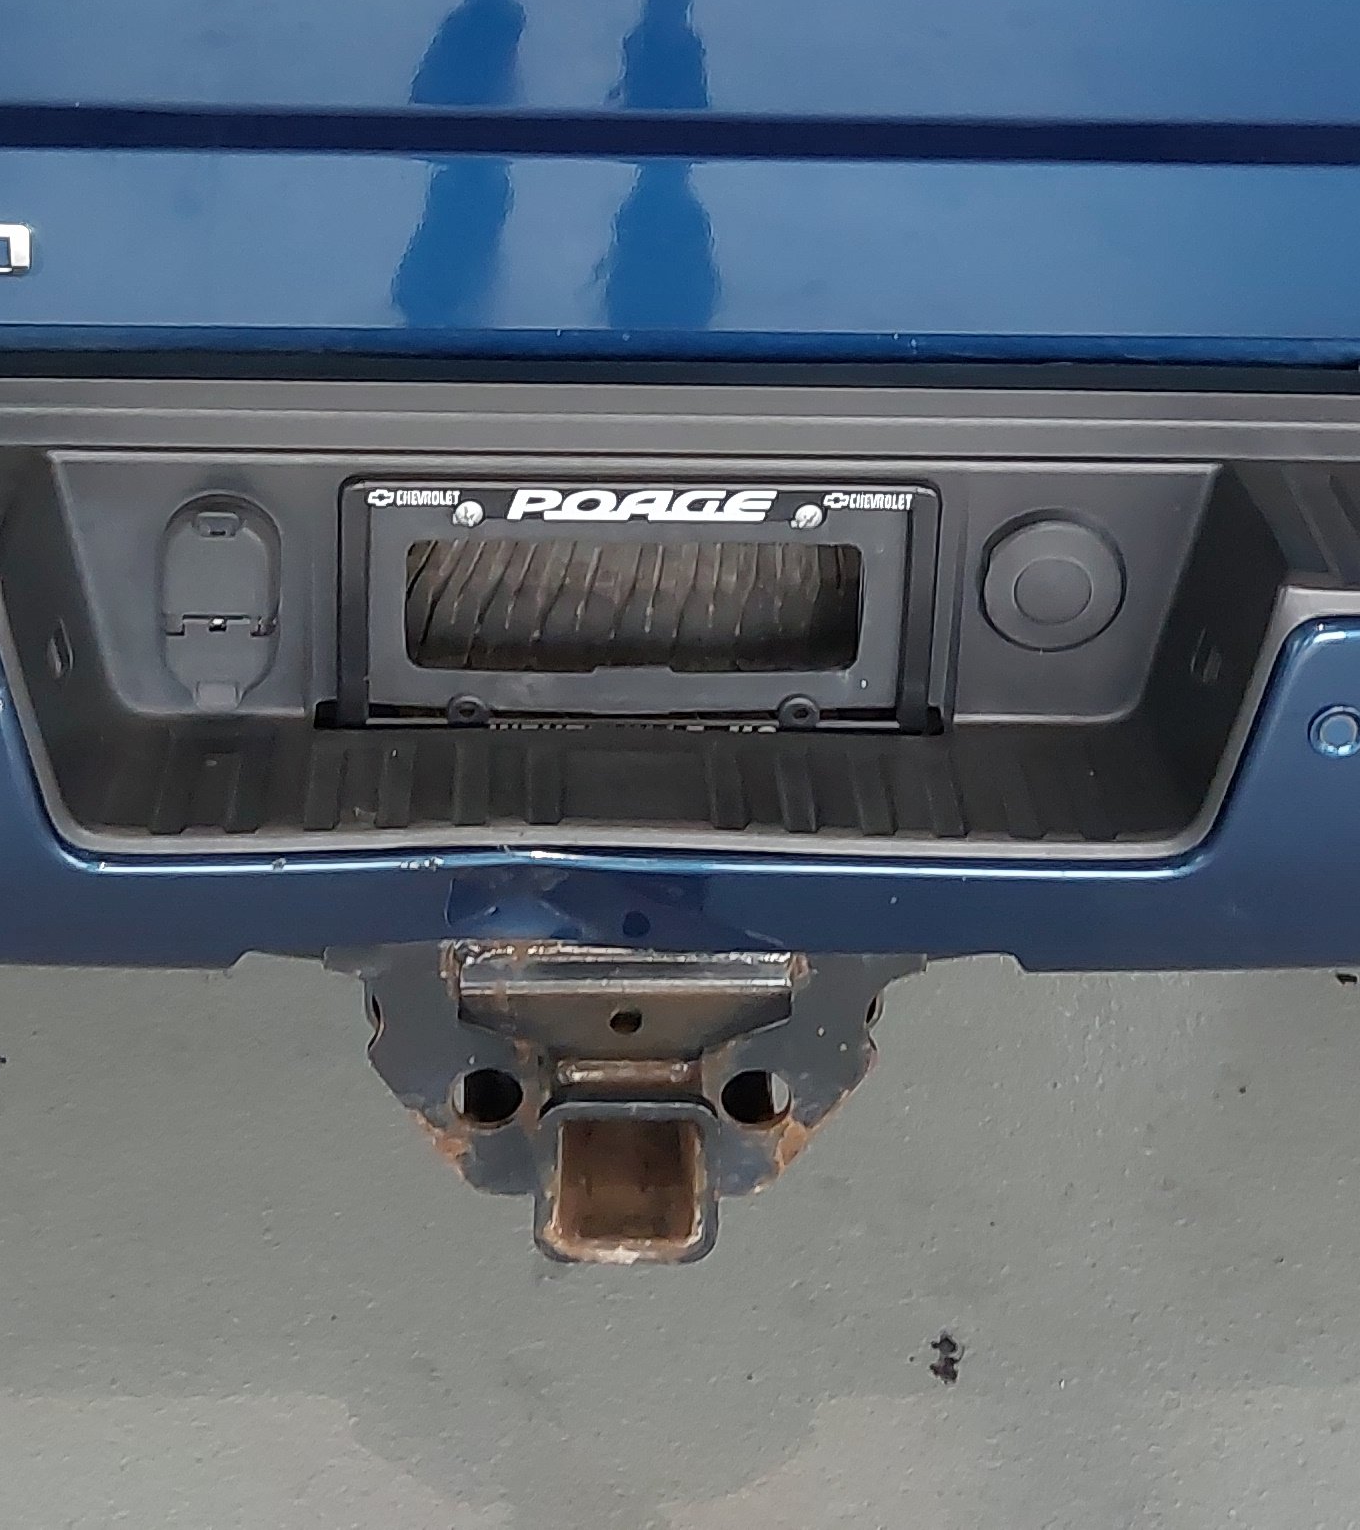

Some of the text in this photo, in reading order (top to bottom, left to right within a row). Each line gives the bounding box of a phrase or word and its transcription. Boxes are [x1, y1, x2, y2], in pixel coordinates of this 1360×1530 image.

[396, 490, 460, 506] CHEVROLET
[506, 488, 779, 522] POAGE
[849, 493, 913, 510] CHEVROLET
